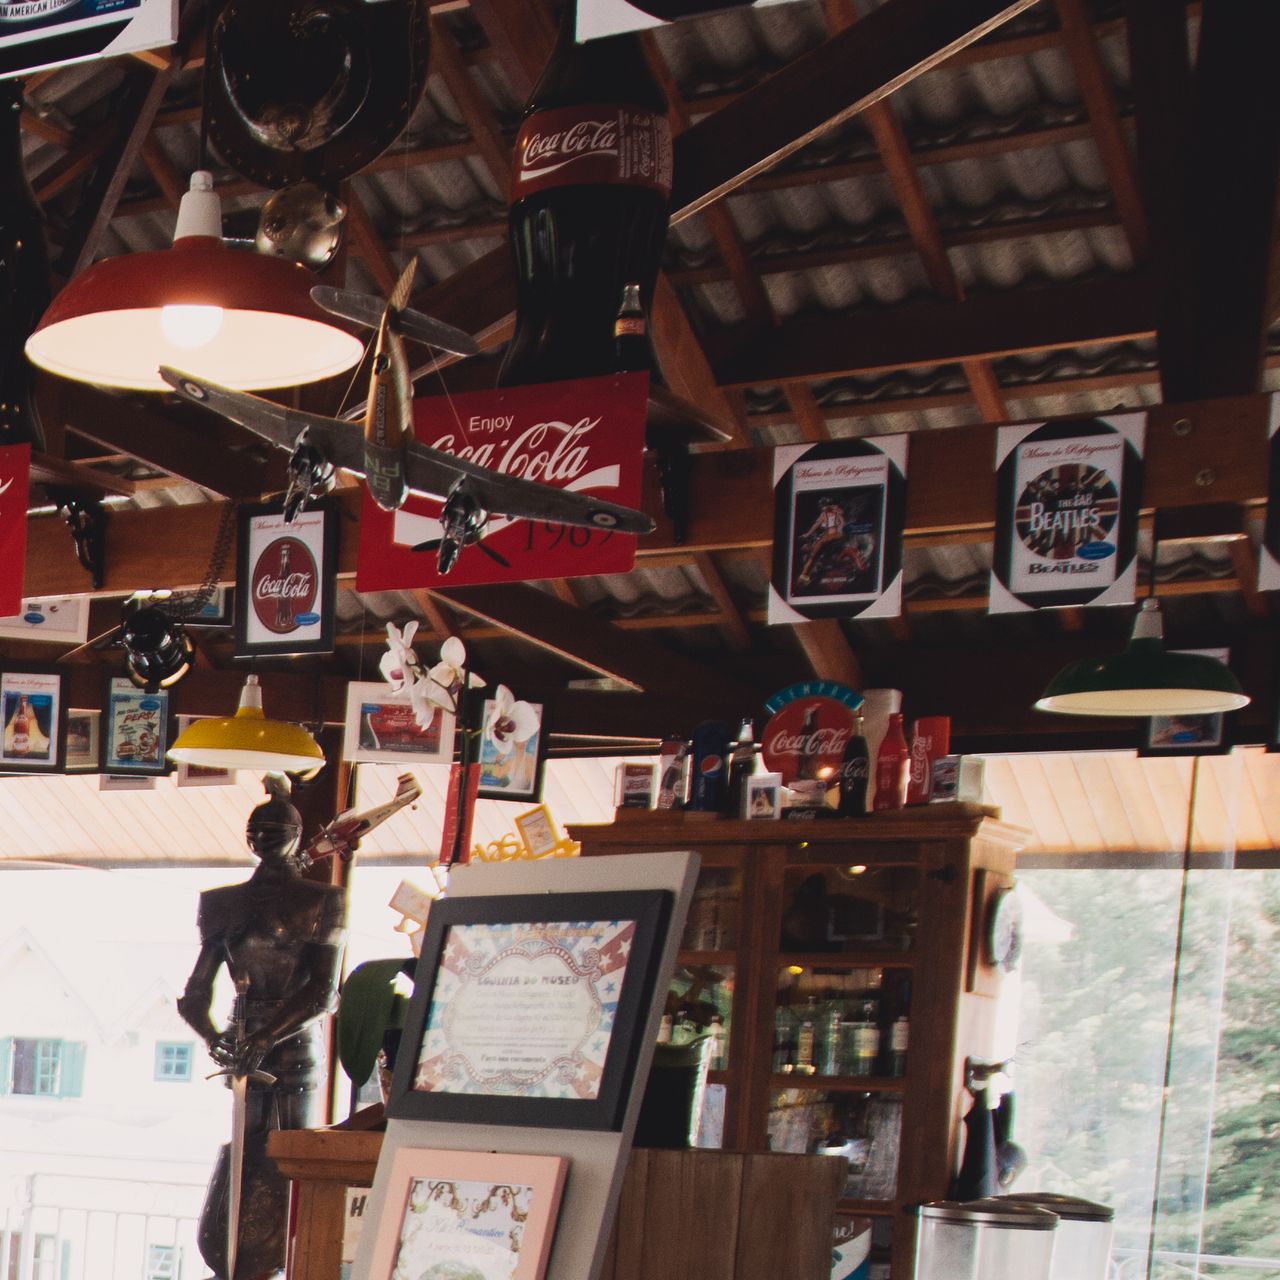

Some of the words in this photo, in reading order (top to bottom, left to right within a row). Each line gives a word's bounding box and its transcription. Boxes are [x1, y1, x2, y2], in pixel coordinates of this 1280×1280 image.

[10, 3, 48, 17] AMERICAN
[523, 120, 618, 167] Coca-Cola
[469, 414, 515, 437] Enjoy
[1029, 501, 1101, 539] BEATLES
[1029, 562, 1101, 576] BEATLES
[256, 571, 313, 600] Coca-Cola
[770, 727, 849, 756] Coca-Cola
[350, 1195, 367, 1217] H
